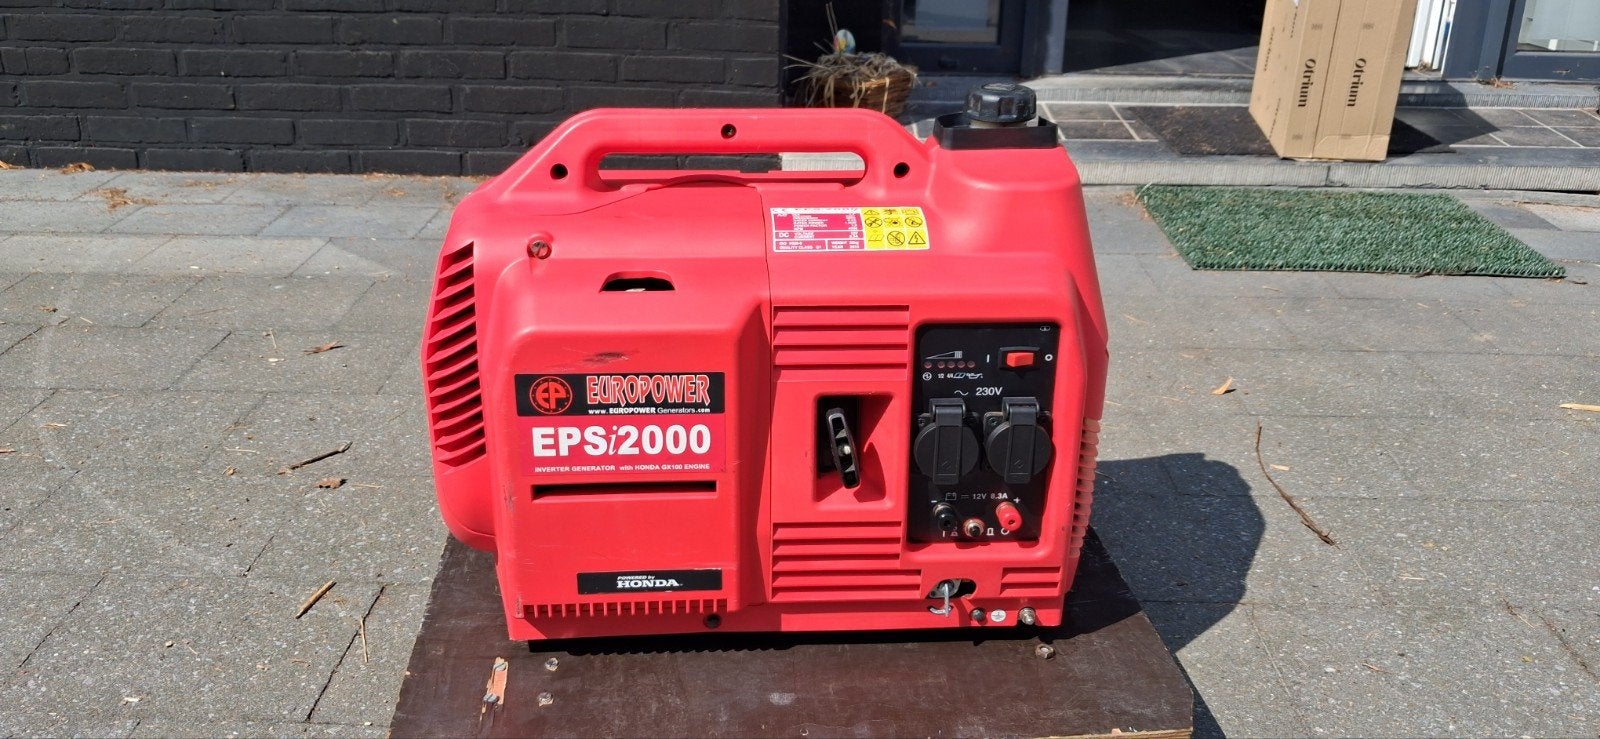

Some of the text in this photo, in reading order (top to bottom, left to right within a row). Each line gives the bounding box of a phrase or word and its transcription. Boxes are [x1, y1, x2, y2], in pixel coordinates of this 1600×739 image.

[1298, 58, 1317, 107] Otrium
[1347, 58, 1367, 107] Otrium
[587, 375, 711, 406] EUROPOWER
[975, 386, 1003, 396] 230V
[657, 406, 696, 414] Generators
[532, 424, 711, 457] EPSi2000
[617, 579, 679, 588] HONDA
